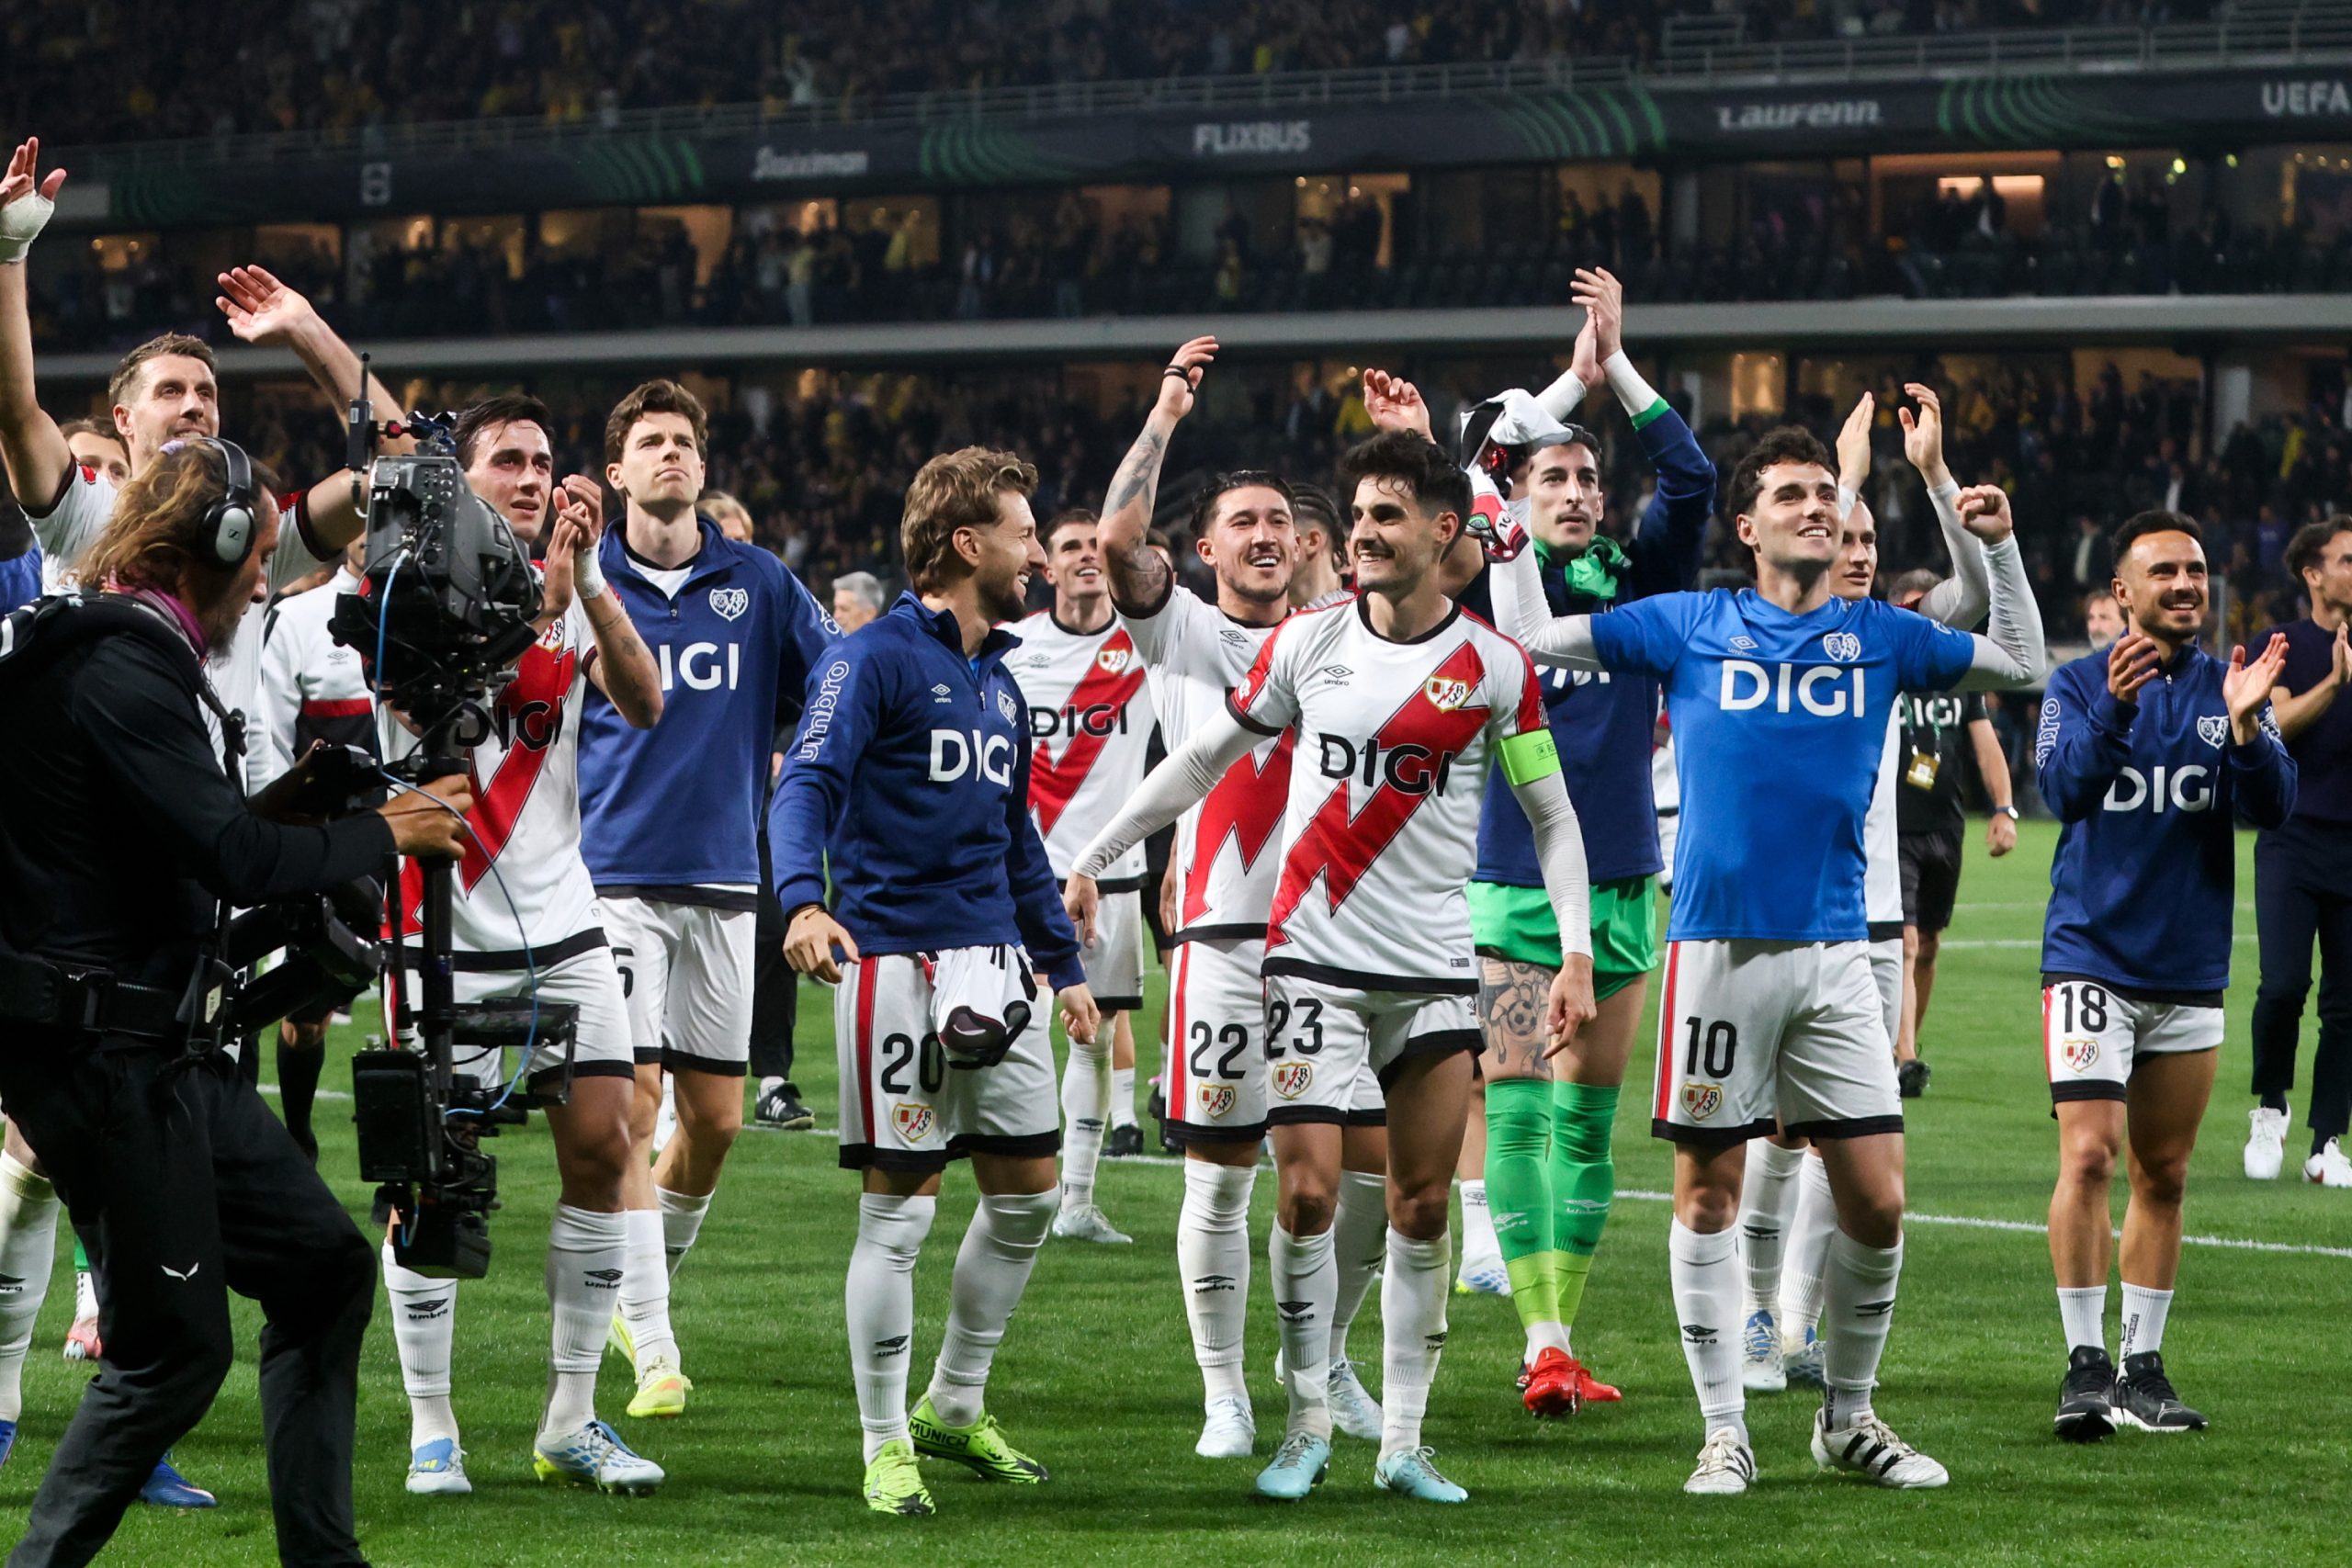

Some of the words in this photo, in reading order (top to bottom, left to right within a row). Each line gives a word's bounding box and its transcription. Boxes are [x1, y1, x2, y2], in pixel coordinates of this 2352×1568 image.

[2262, 81, 2351, 115] UEFA
[1220, 637, 1244, 649] umbro
[659, 641, 739, 691] IGI
[1720, 660, 1865, 718] DIGI
[797, 660, 849, 761] umbro
[1029, 702, 1126, 738] DIGI
[1318, 732, 1454, 798] DIGI
[1267, 998, 1324, 1057] 23
[2061, 985, 2108, 1033] 18
[880, 1032, 944, 1095] 20
[1191, 1021, 1248, 1079] 22
[1685, 1016, 1737, 1079] 10
[584, 1280, 622, 1290] umbr
[1194, 1284, 1236, 1293] umbro
[407, 1308, 448, 1321] umbro
[1280, 1313, 1315, 1323] umbro
[1684, 1337, 1717, 1345] umbro
[909, 1420, 970, 1450] MUNICH
